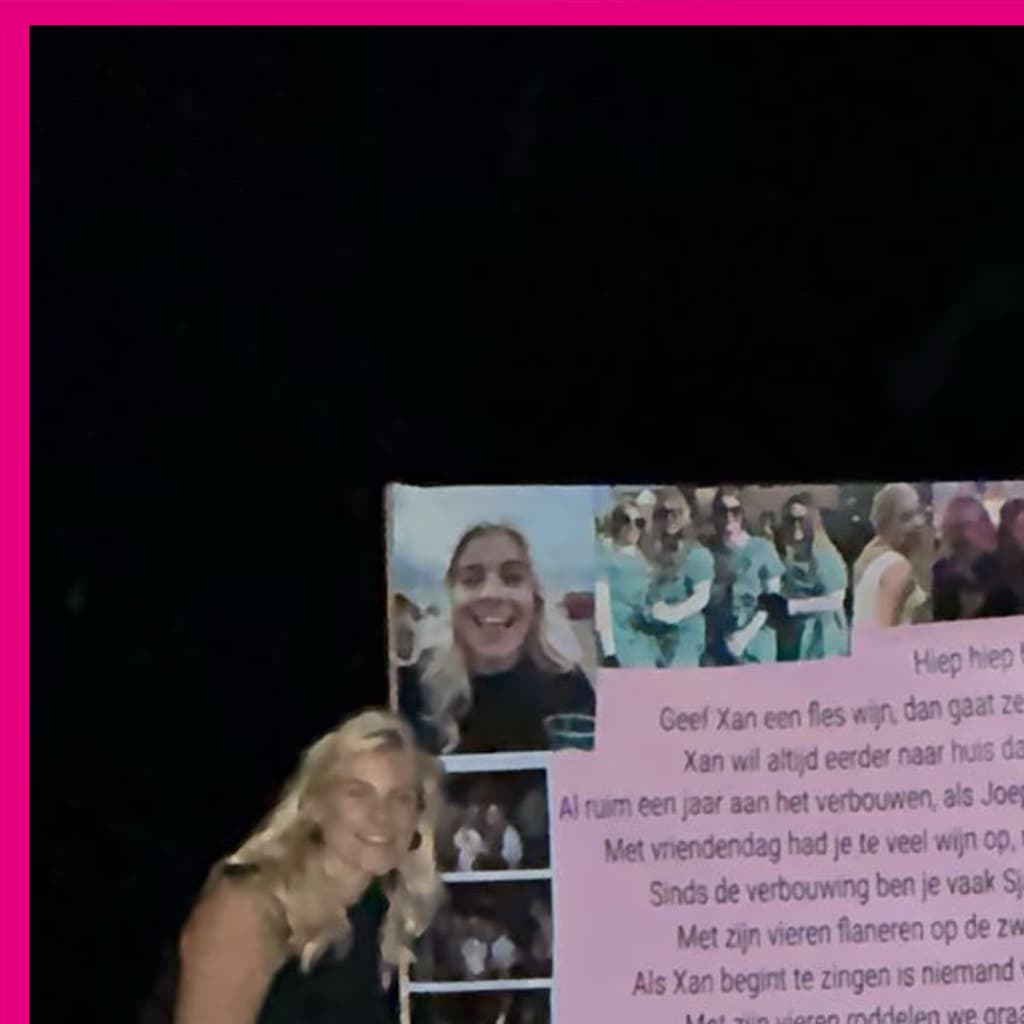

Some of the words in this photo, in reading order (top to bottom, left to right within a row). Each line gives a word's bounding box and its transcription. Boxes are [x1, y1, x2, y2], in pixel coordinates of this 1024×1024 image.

[914, 648, 962, 679] Hiep
[970, 645, 1014, 672] hiep
[660, 706, 708, 732] Geef
[716, 708, 758, 731] Xan
[764, 709, 802, 730] een
[808, 700, 846, 728] fles
[904, 695, 942, 722] dan
[949, 694, 994, 726] gaat
[683, 750, 724, 773] Xan
[731, 747, 760, 772] wil
[768, 746, 818, 778] altijd
[825, 744, 892, 771] eerder
[898, 745, 943, 766] naar
[951, 739, 994, 763] huis
[559, 794, 577, 820] Al
[584, 798, 632, 819] ruim
[638, 796, 676, 817] een
[681, 795, 722, 822] jaar
[730, 795, 770, 815] aan
[776, 789, 811, 814] het
[816, 788, 938, 814] verbouwen,
[944, 782, 973, 807] als
[605, 837, 645, 863] Met
[651, 832, 782, 864] vriendendag
[788, 830, 828, 856] had
[832, 835, 852, 862] je
[860, 833, 879, 855] te
[886, 828, 929, 854] veel
[934, 828, 978, 859] wijn
[650, 879, 709, 907] Sinds
[715, 876, 741, 904] de
[748, 875, 871, 906] verbouwing
[877, 872, 916, 898] ben
[920, 871, 942, 903] je
[947, 868, 996, 896] vaak
[678, 924, 719, 950] Met
[726, 922, 761, 955] zijn
[768, 921, 832, 947] vieren
[839, 915, 925, 944] flaneren
[932, 919, 959, 946] op
[966, 912, 992, 940] de
[632, 970, 667, 996] Als
[673, 969, 714, 995] Xan
[720, 966, 787, 999] begint
[794, 968, 814, 991] te
[821, 967, 890, 995] zingen
[896, 967, 914, 988] is
[921, 956, 1014, 985] niemand
